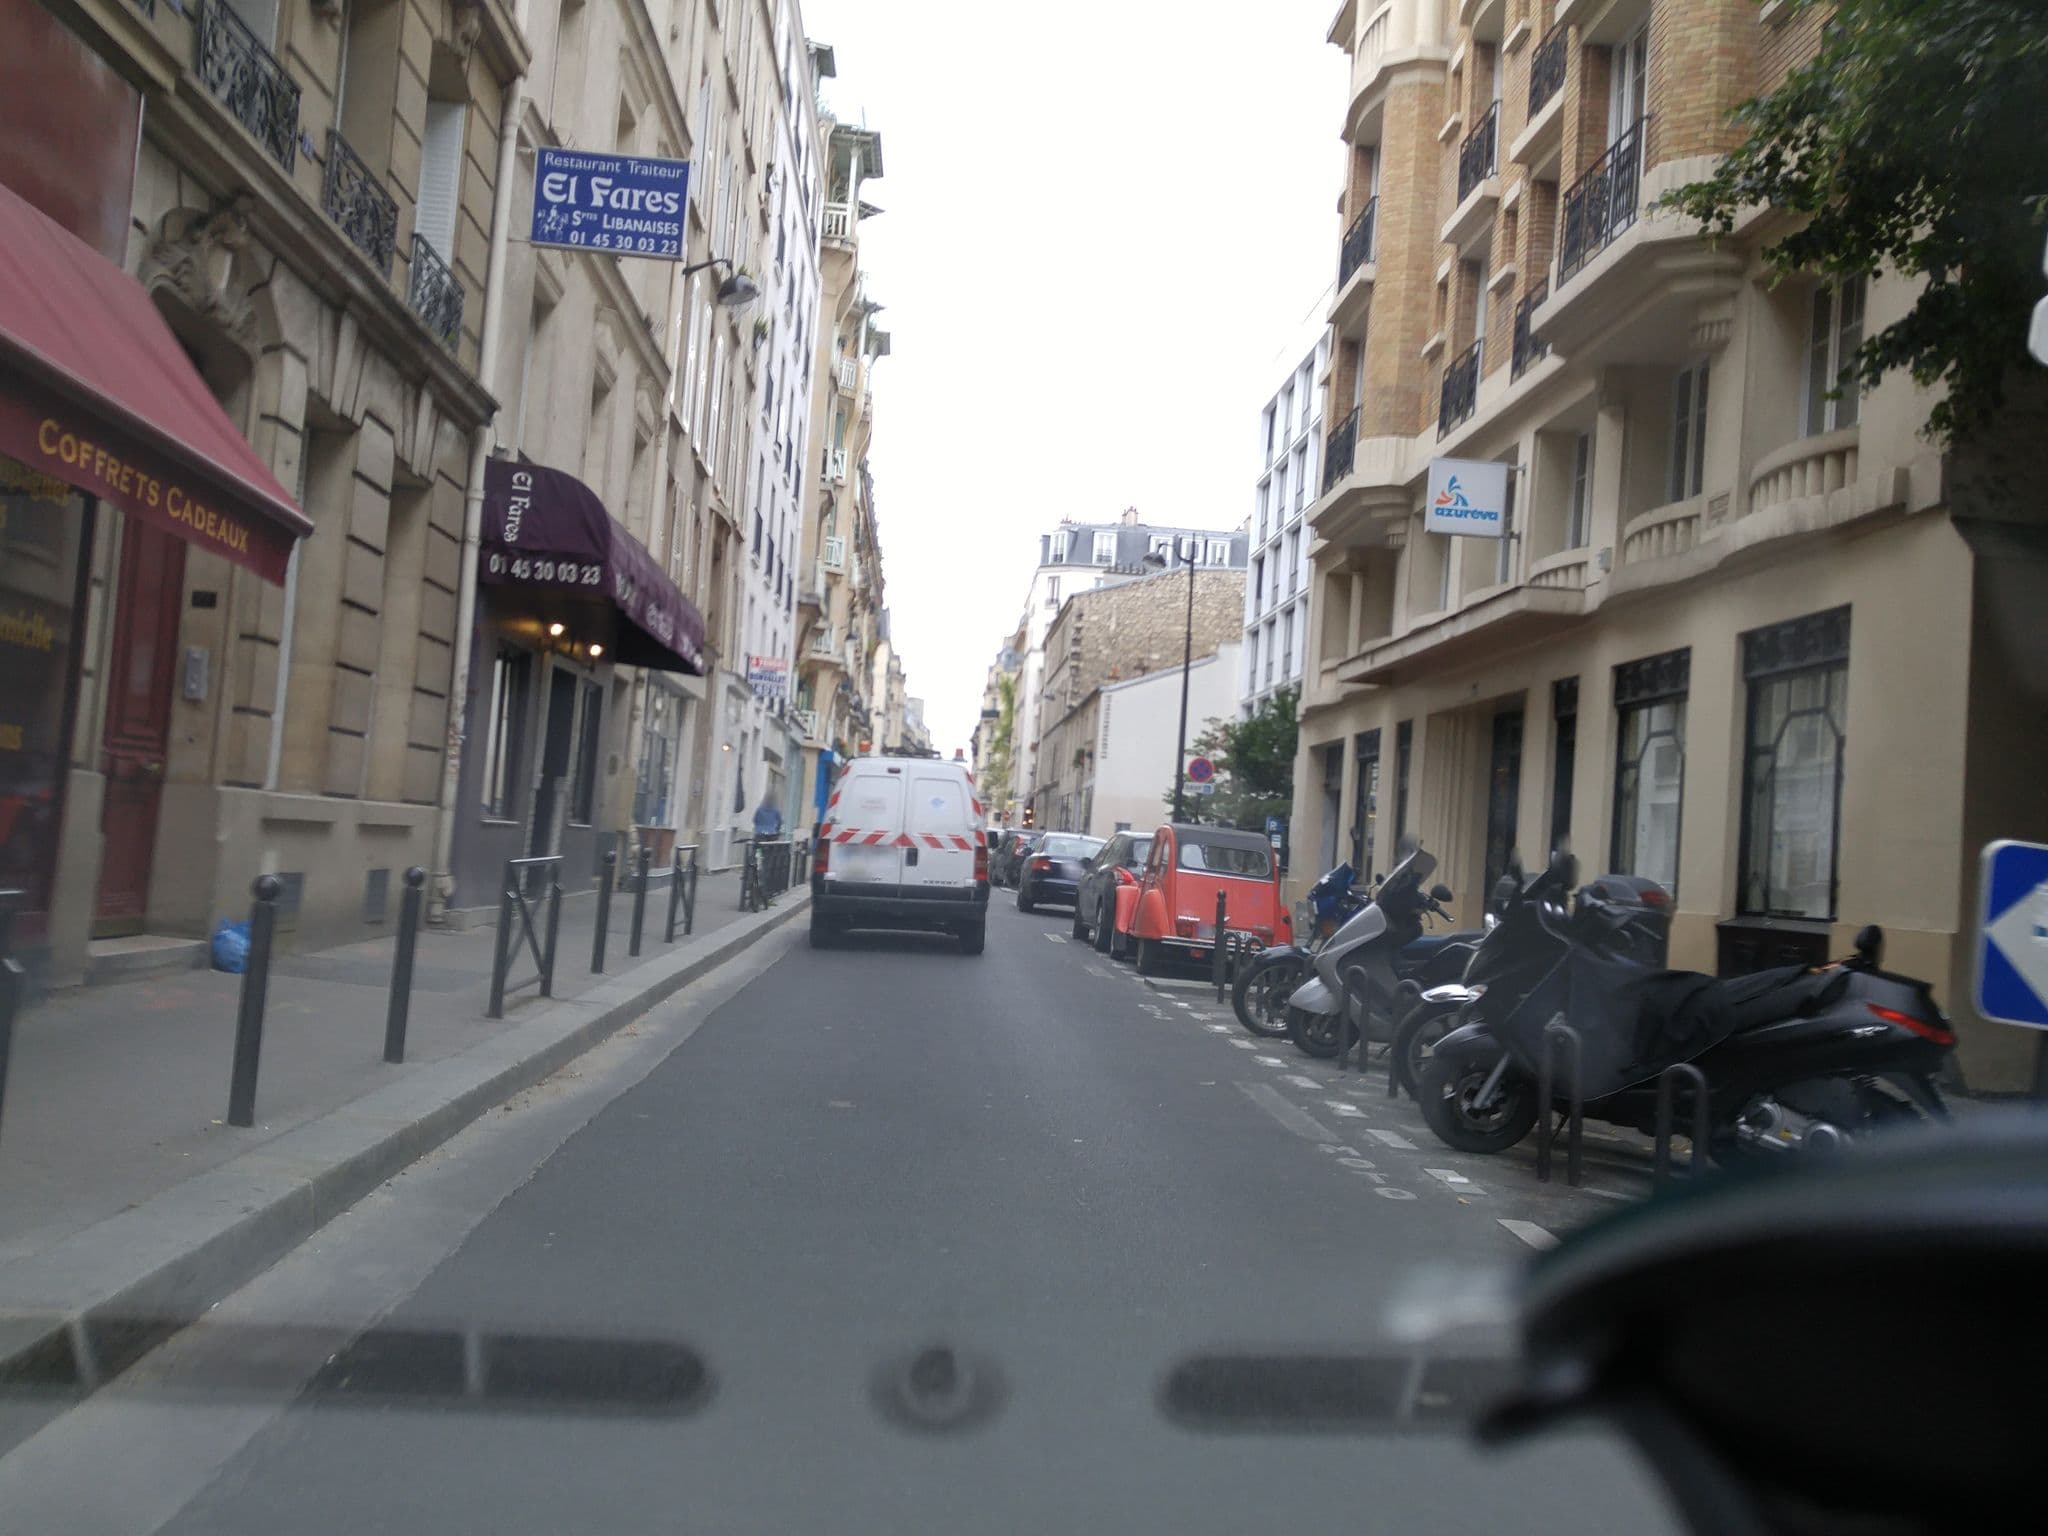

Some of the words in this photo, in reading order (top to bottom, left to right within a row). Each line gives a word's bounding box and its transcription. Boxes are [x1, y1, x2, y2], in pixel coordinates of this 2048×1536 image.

[545, 152, 621, 173] Restaurant
[627, 160, 683, 178] Traiteur
[542, 172, 578, 204] El
[590, 177, 680, 214] Fares
[603, 214, 679, 235] LIBANAISES
[570, 231, 586, 244] 01
[593, 233, 610, 247] 45
[615, 235, 633, 249] 30
[638, 238, 655, 251] 03
[661, 240, 678, 253] 23
[38, 418, 161, 507] COFFRETS
[166, 486, 249, 552] CADEAUX
[512, 471, 533, 492] El
[503, 496, 530, 543] Fares
[489, 553, 507, 575] 01
[511, 559, 530, 579] 45
[534, 561, 554, 581] 30
[558, 563, 578, 583] 03
[581, 565, 601, 586] 23
